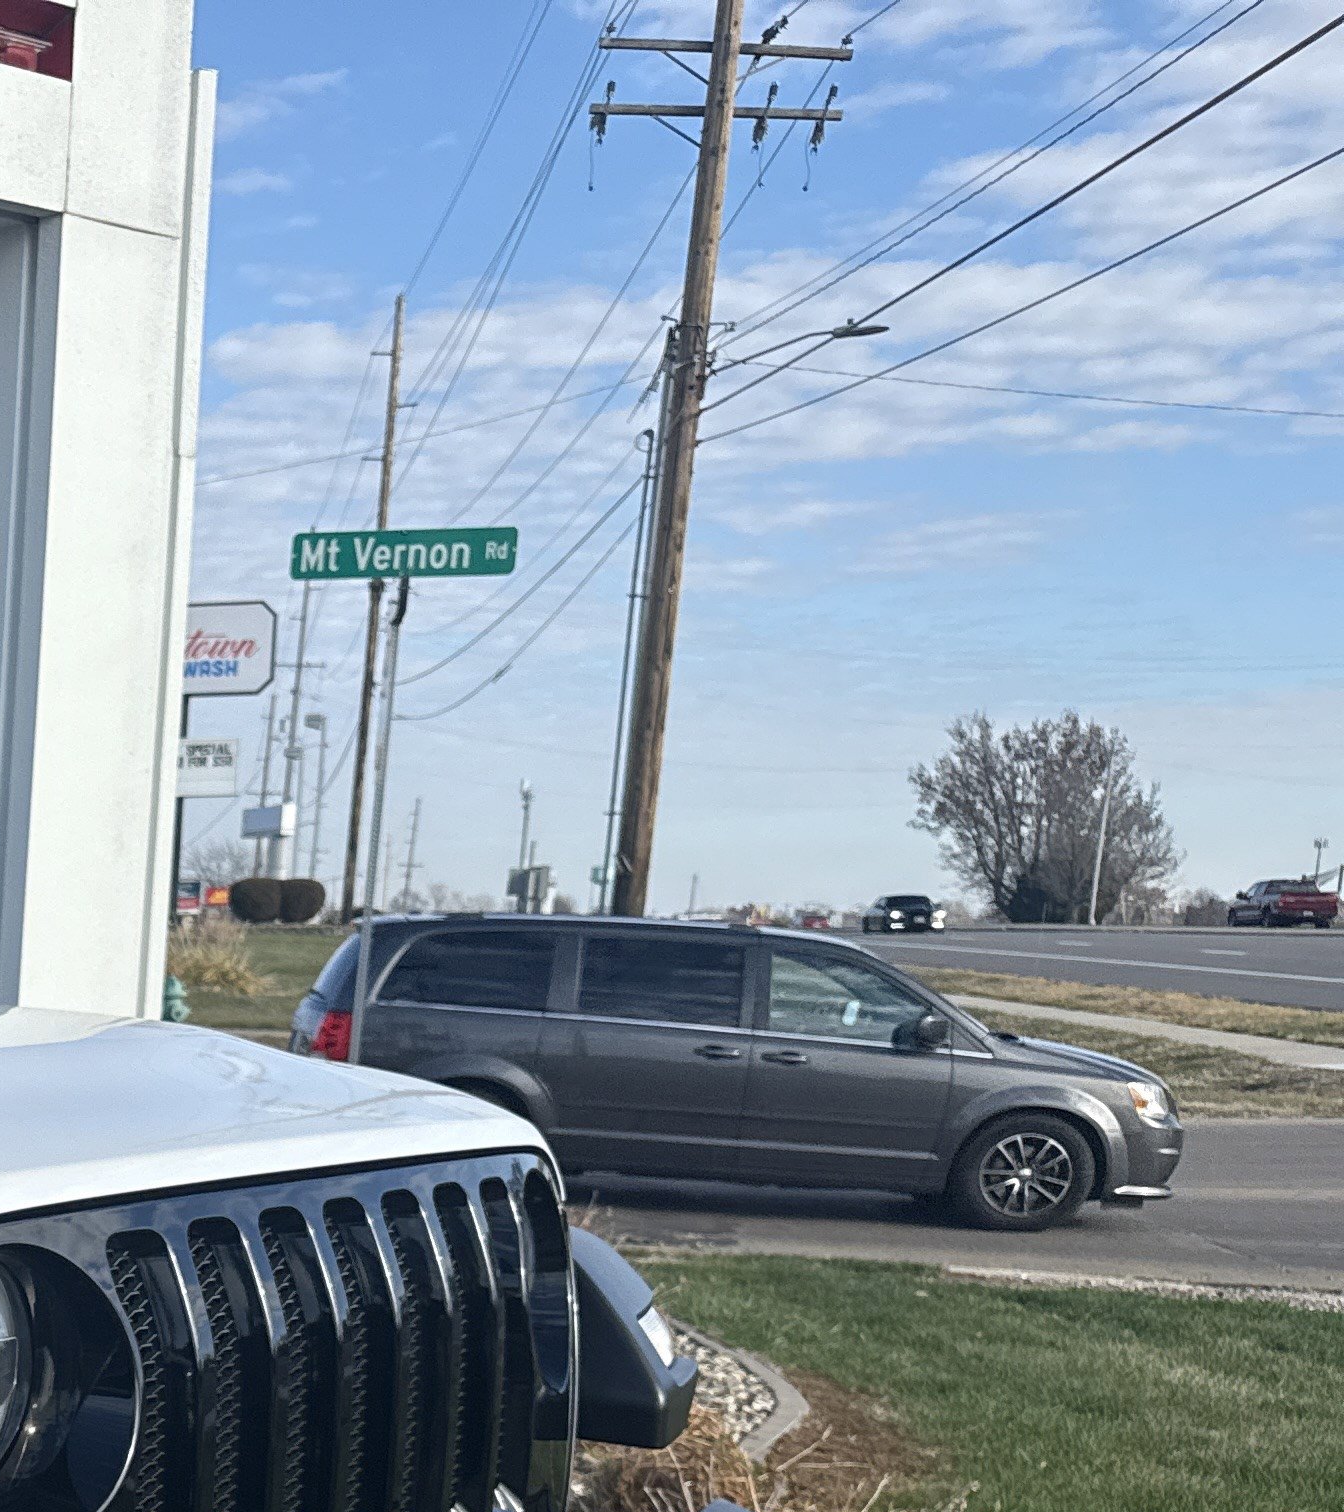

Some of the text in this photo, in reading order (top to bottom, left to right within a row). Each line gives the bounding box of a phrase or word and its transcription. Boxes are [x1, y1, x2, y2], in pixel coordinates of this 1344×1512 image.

[299, 536, 510, 573] Mt Vernon Rd
